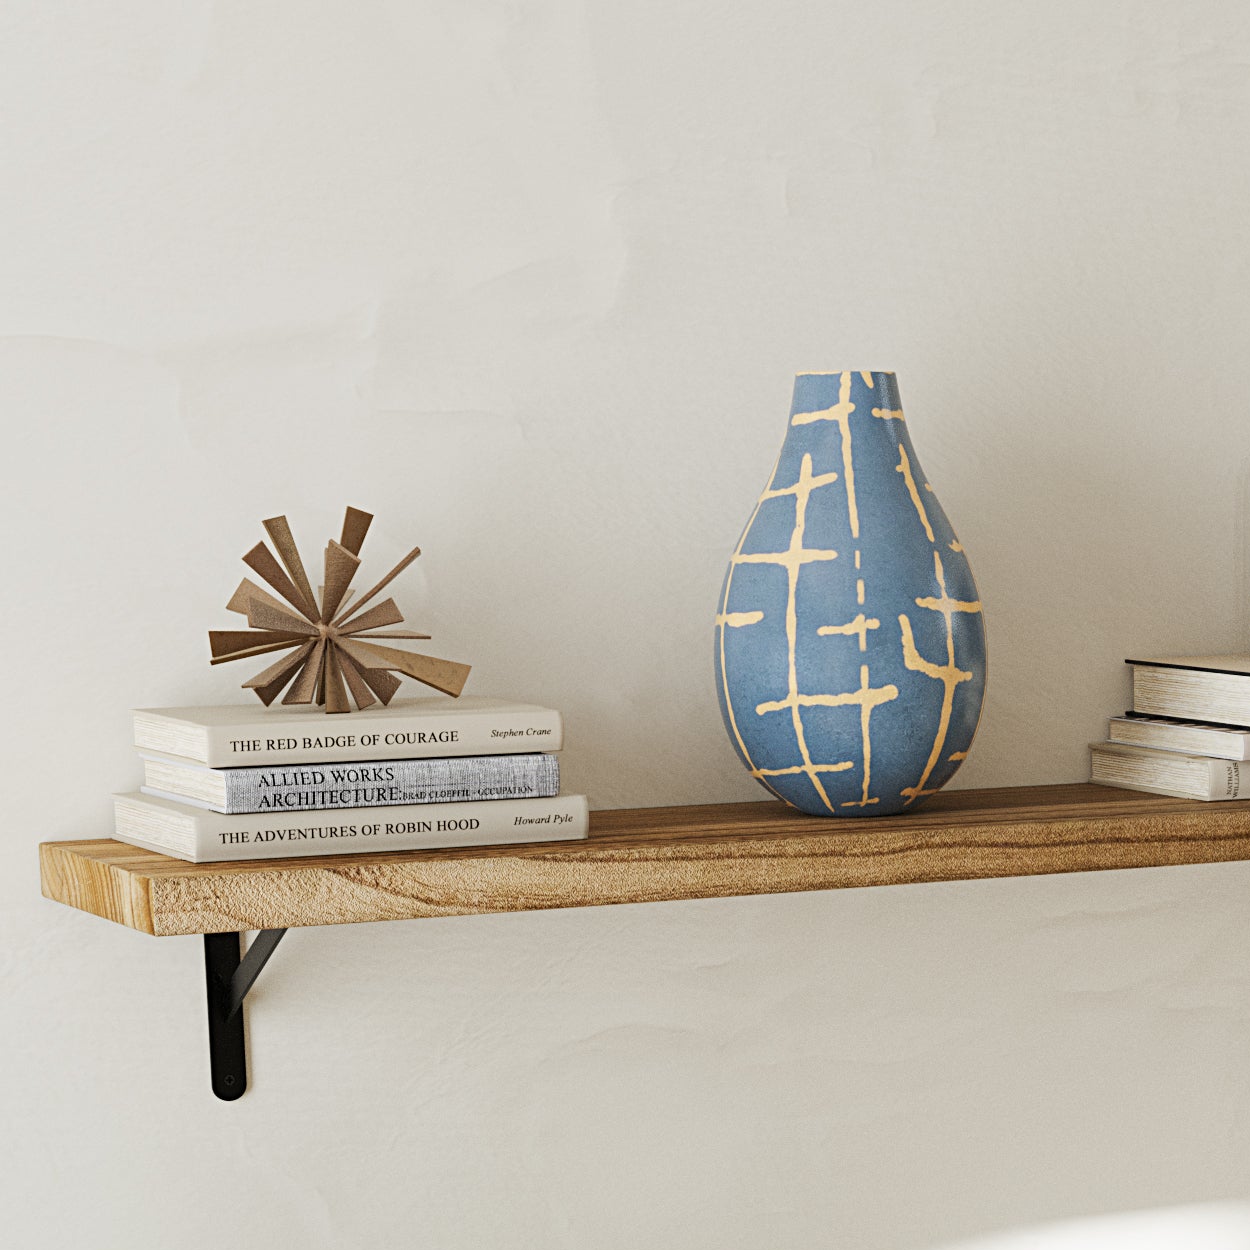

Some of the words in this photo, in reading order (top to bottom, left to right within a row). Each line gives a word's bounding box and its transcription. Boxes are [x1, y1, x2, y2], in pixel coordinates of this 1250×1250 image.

[230, 740, 261, 752] THE
[266, 738, 297, 750] RED
[302, 735, 356, 749] BADGE
[360, 734, 381, 746] OF
[384, 730, 459, 745] COURAGE
[490, 729, 524, 739] Stephen
[525, 727, 552, 736] Crane
[259, 771, 325, 787] ALLIED
[331, 768, 395, 783] WORKS
[259, 787, 402, 808] ARCHITECTURE:
[403, 791, 426, 800] BRAD
[478, 785, 533, 796] OCCUPATION
[513, 815, 551, 826] Howard
[553, 814, 573, 825] Pyle
[219, 832, 250, 844] THE
[254, 825, 357, 842] ADVENTURES
[361, 824, 381, 836] OF
[385, 821, 432, 834] ROBIN
[436, 818, 480, 832] HOOD
